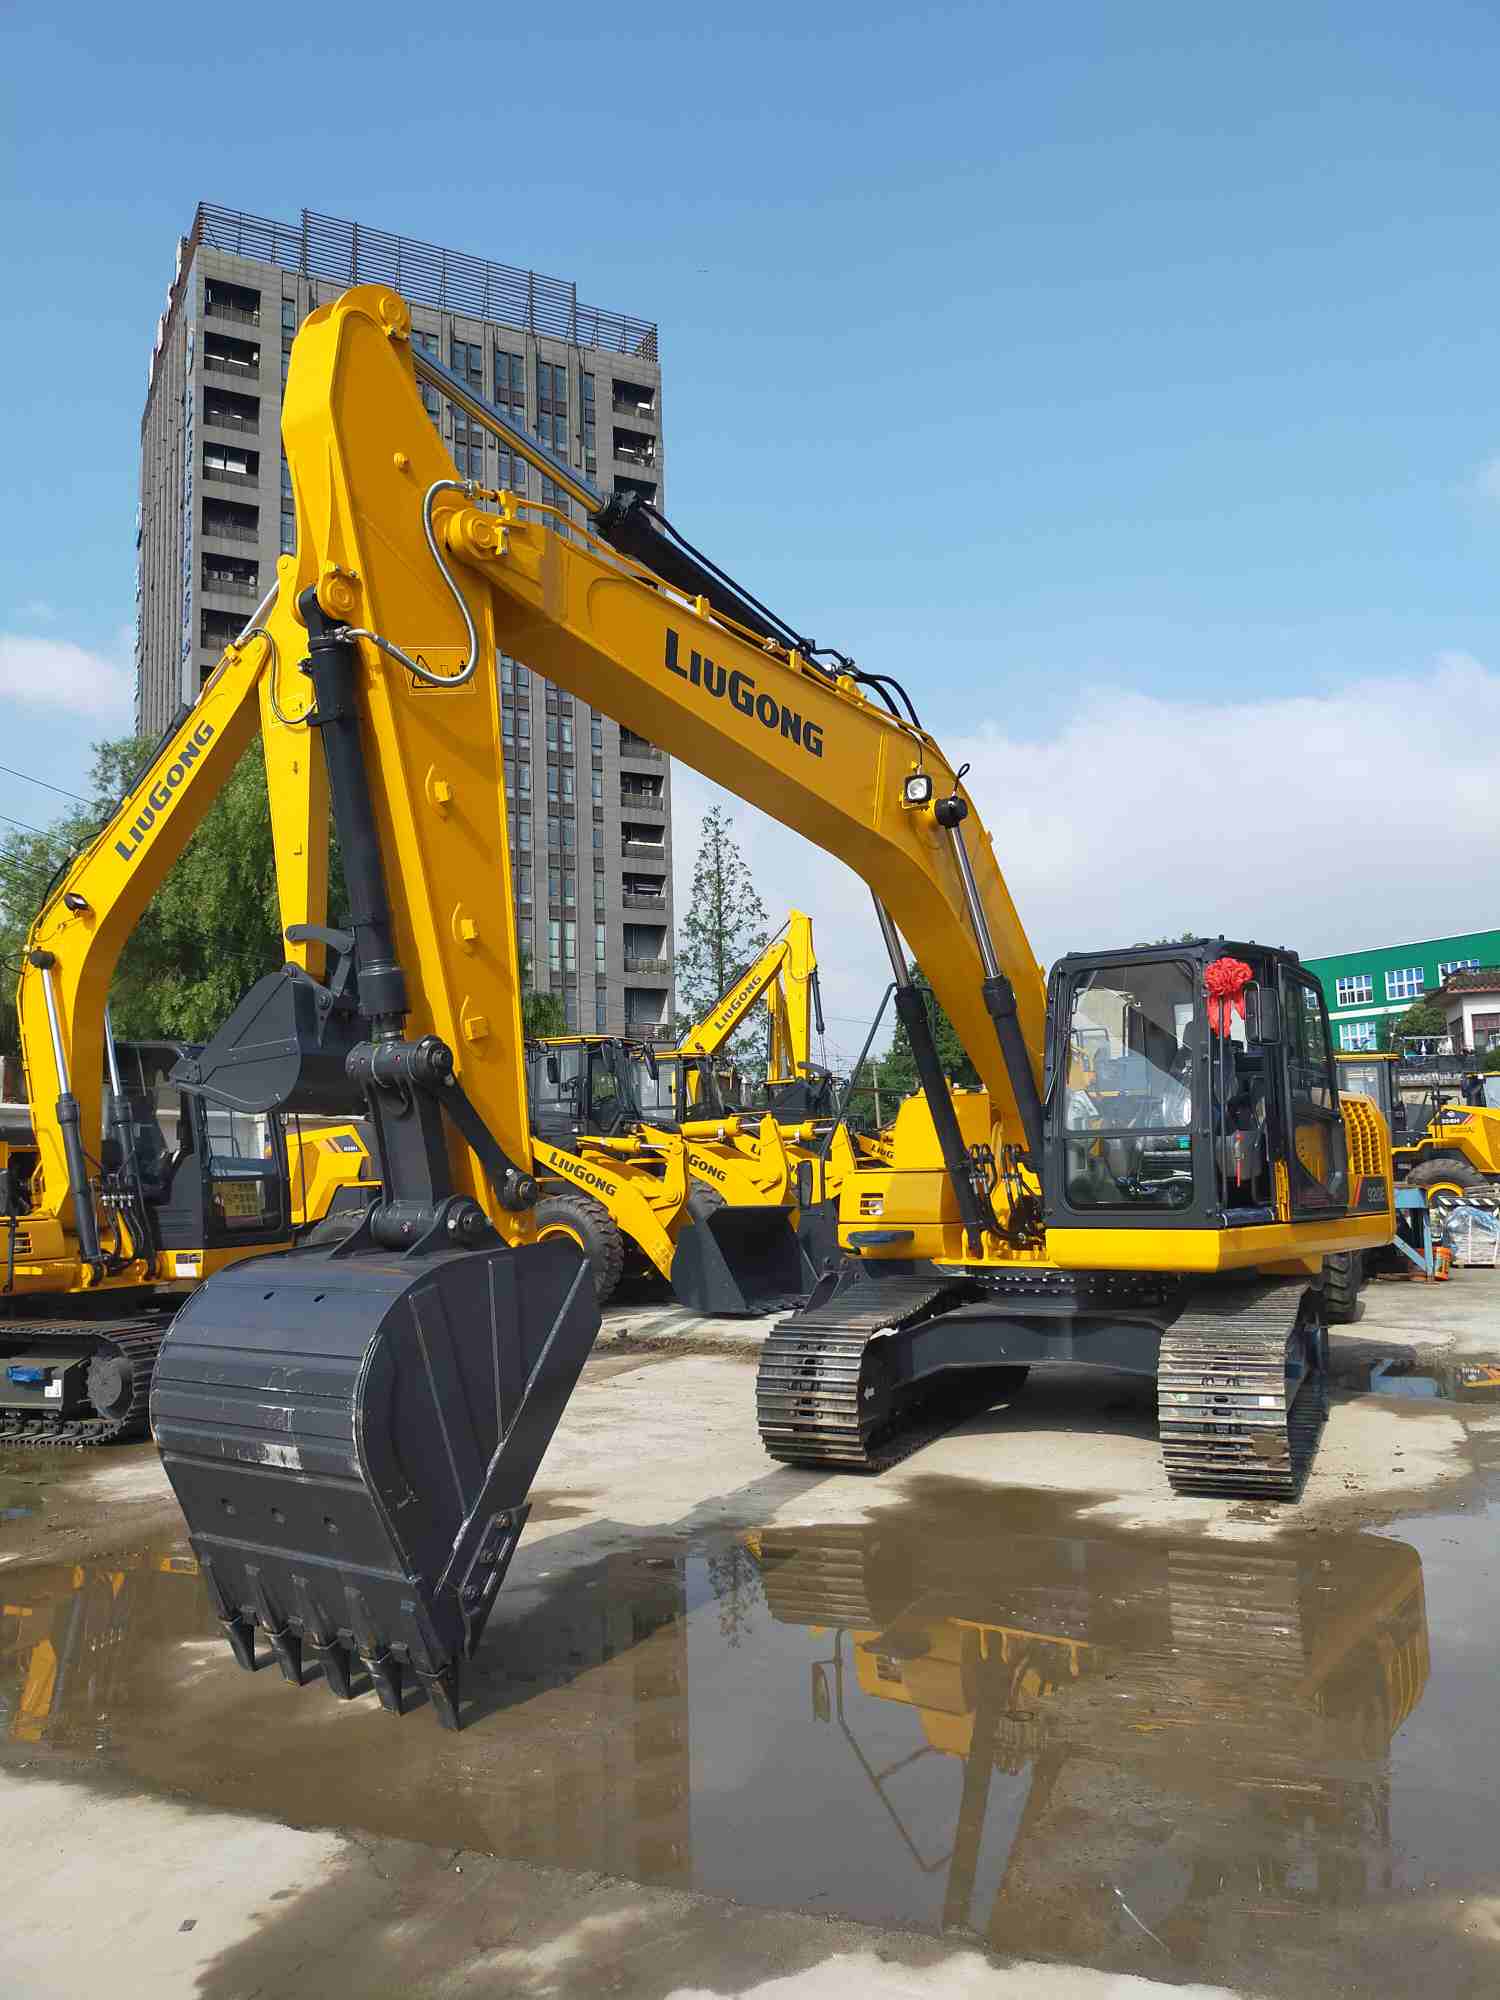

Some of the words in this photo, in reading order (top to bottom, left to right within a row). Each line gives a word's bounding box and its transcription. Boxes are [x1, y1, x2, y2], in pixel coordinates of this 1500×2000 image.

[665, 628, 823, 757] LIUGONG
[115, 720, 216, 861] LIUGONG
[714, 976, 762, 1029] LIUGONG
[549, 1151, 617, 1196] LIUGONG
